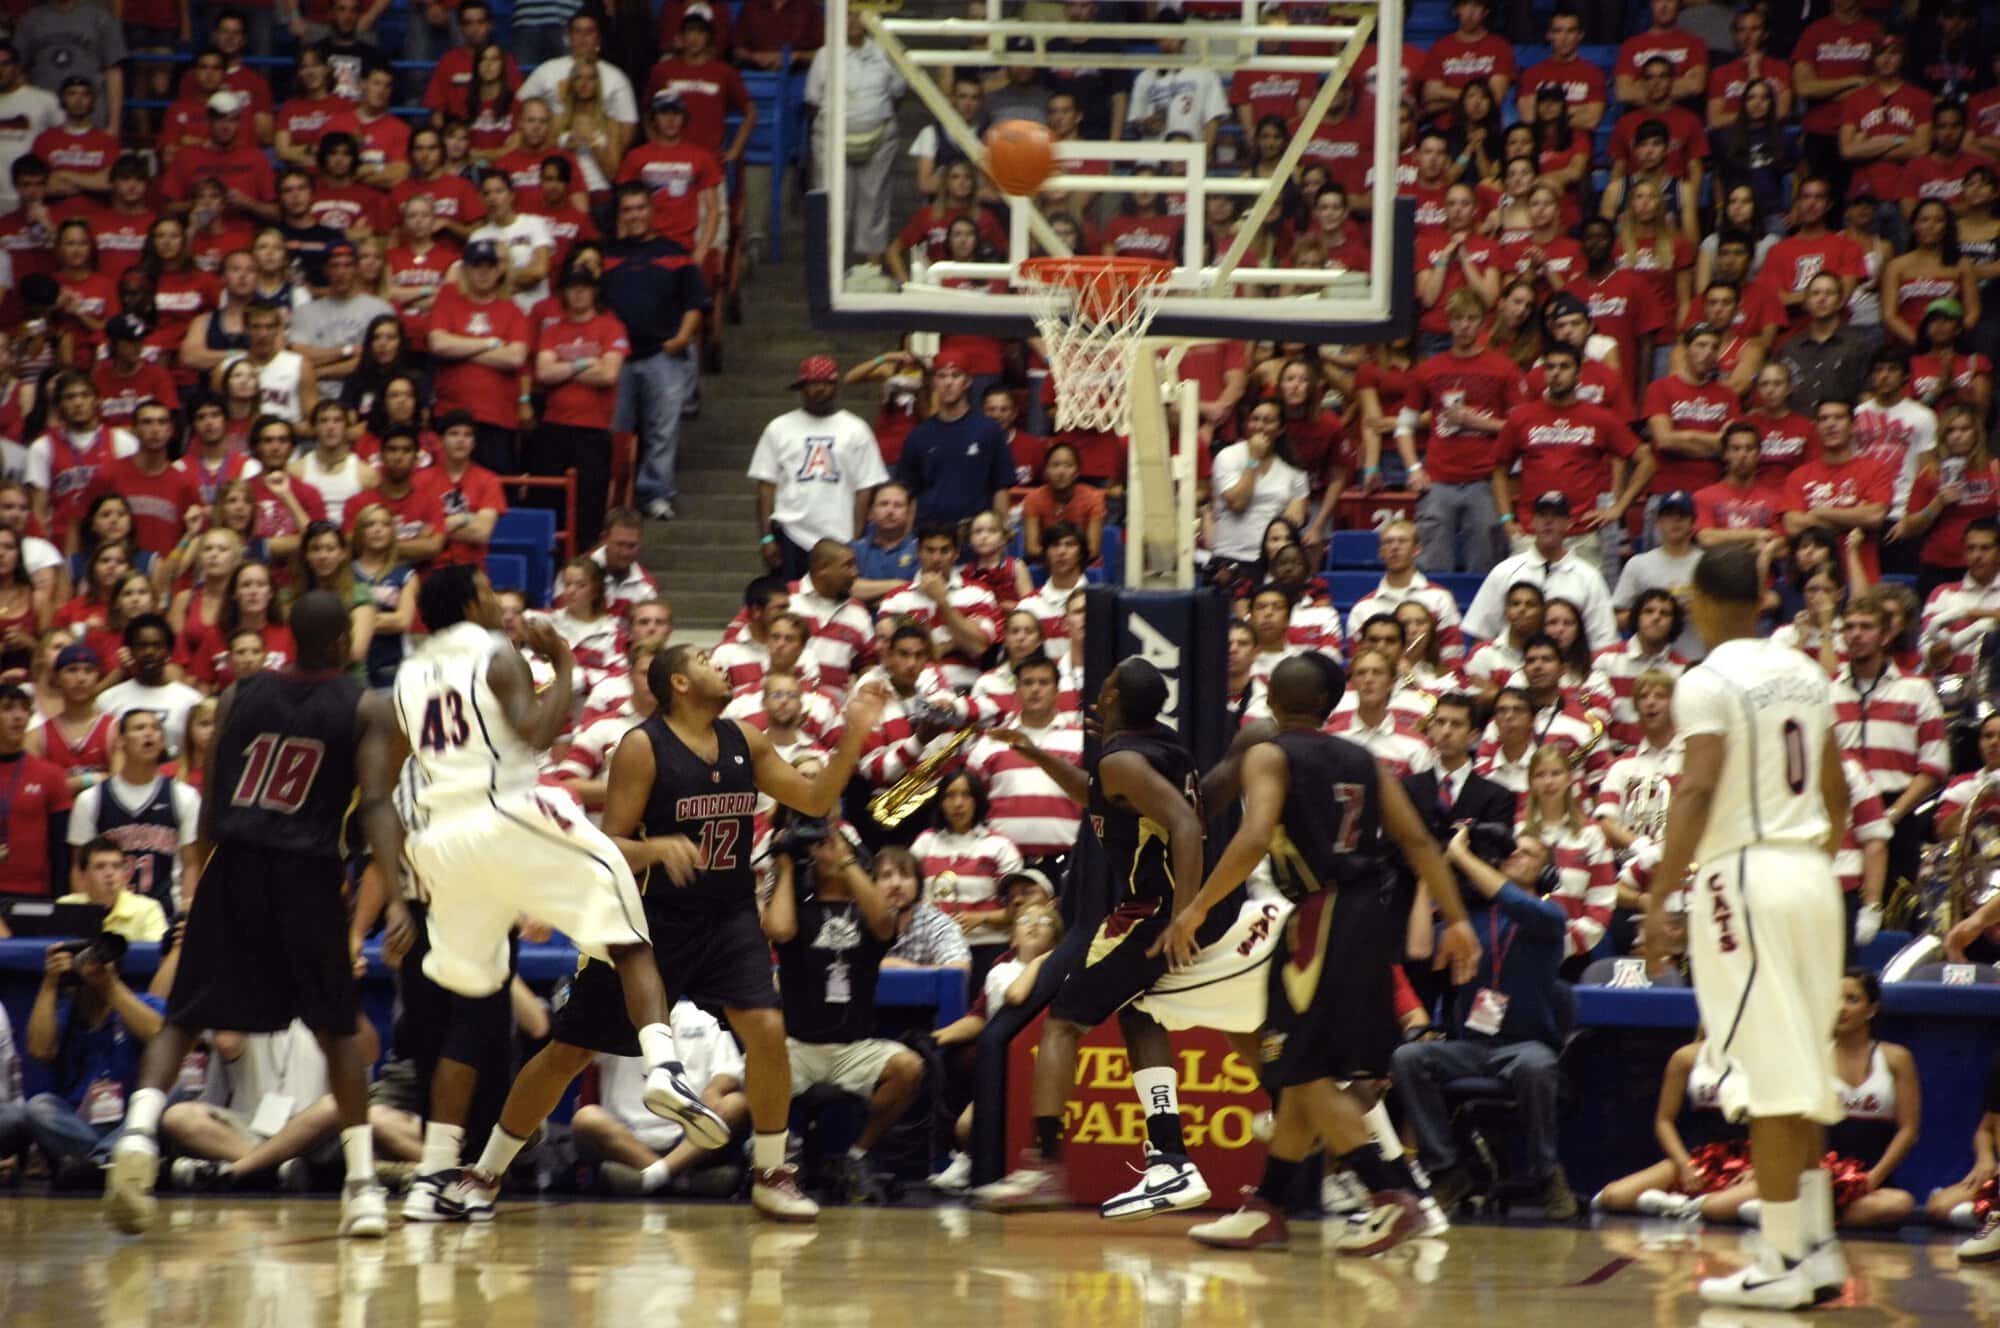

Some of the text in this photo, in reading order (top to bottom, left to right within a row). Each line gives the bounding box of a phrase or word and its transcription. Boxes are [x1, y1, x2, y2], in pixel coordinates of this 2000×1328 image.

[796, 437, 840, 482] A
[420, 687, 471, 756] 43
[1784, 717, 1806, 796] 0
[230, 732, 324, 815] 10
[699, 818, 739, 871] 12
[1333, 783, 1366, 855] 7
[1236, 903, 1282, 957] CATS
[1708, 872, 1739, 953] CATS
